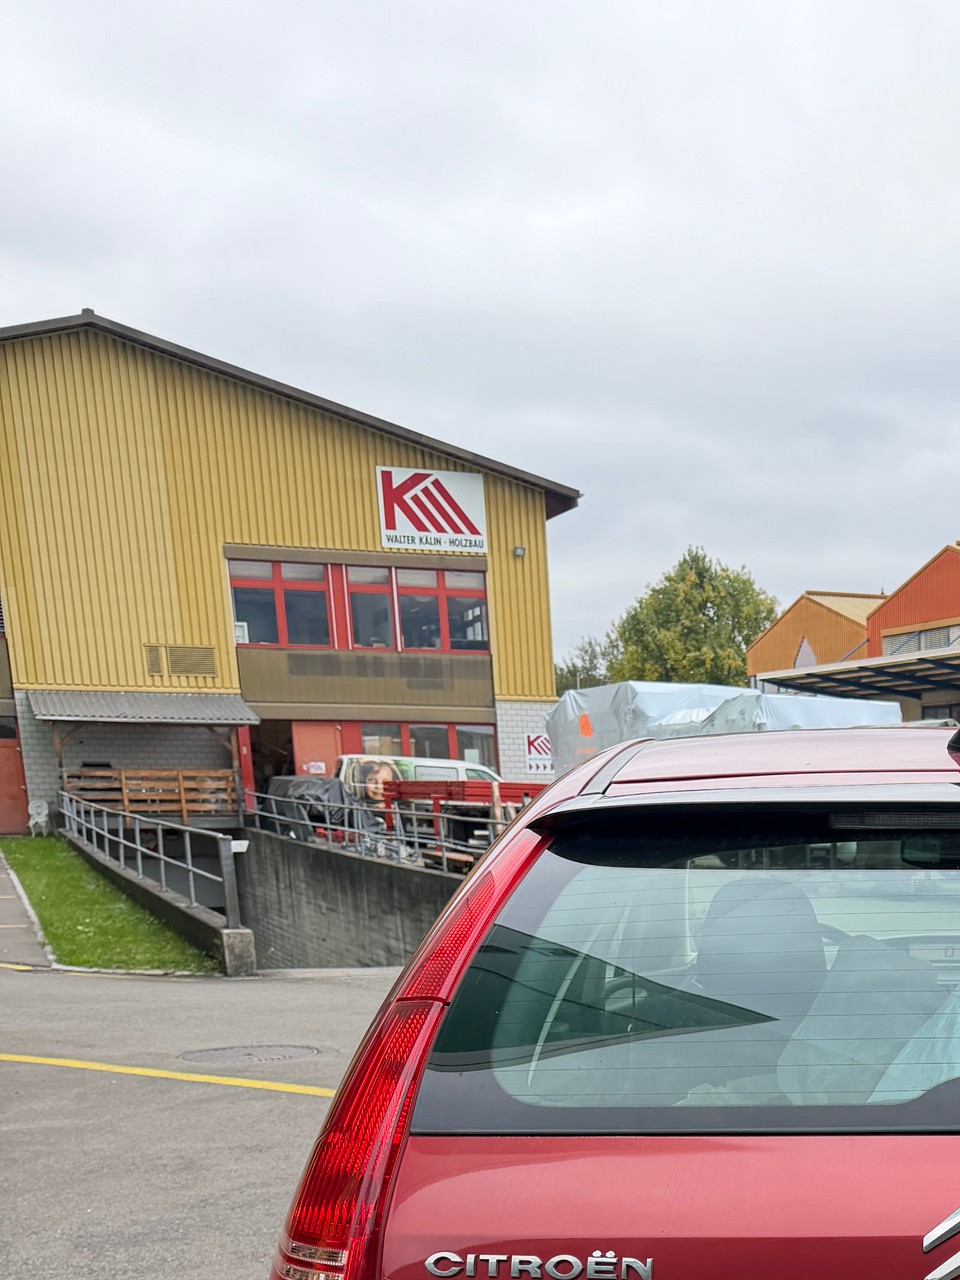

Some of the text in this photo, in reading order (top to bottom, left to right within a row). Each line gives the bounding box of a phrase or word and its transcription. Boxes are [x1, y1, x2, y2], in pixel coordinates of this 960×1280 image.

[386, 534, 417, 545] WALTER
[419, 535, 442, 547] KÄLIN
[448, 538, 484, 549] HOLZBAU
